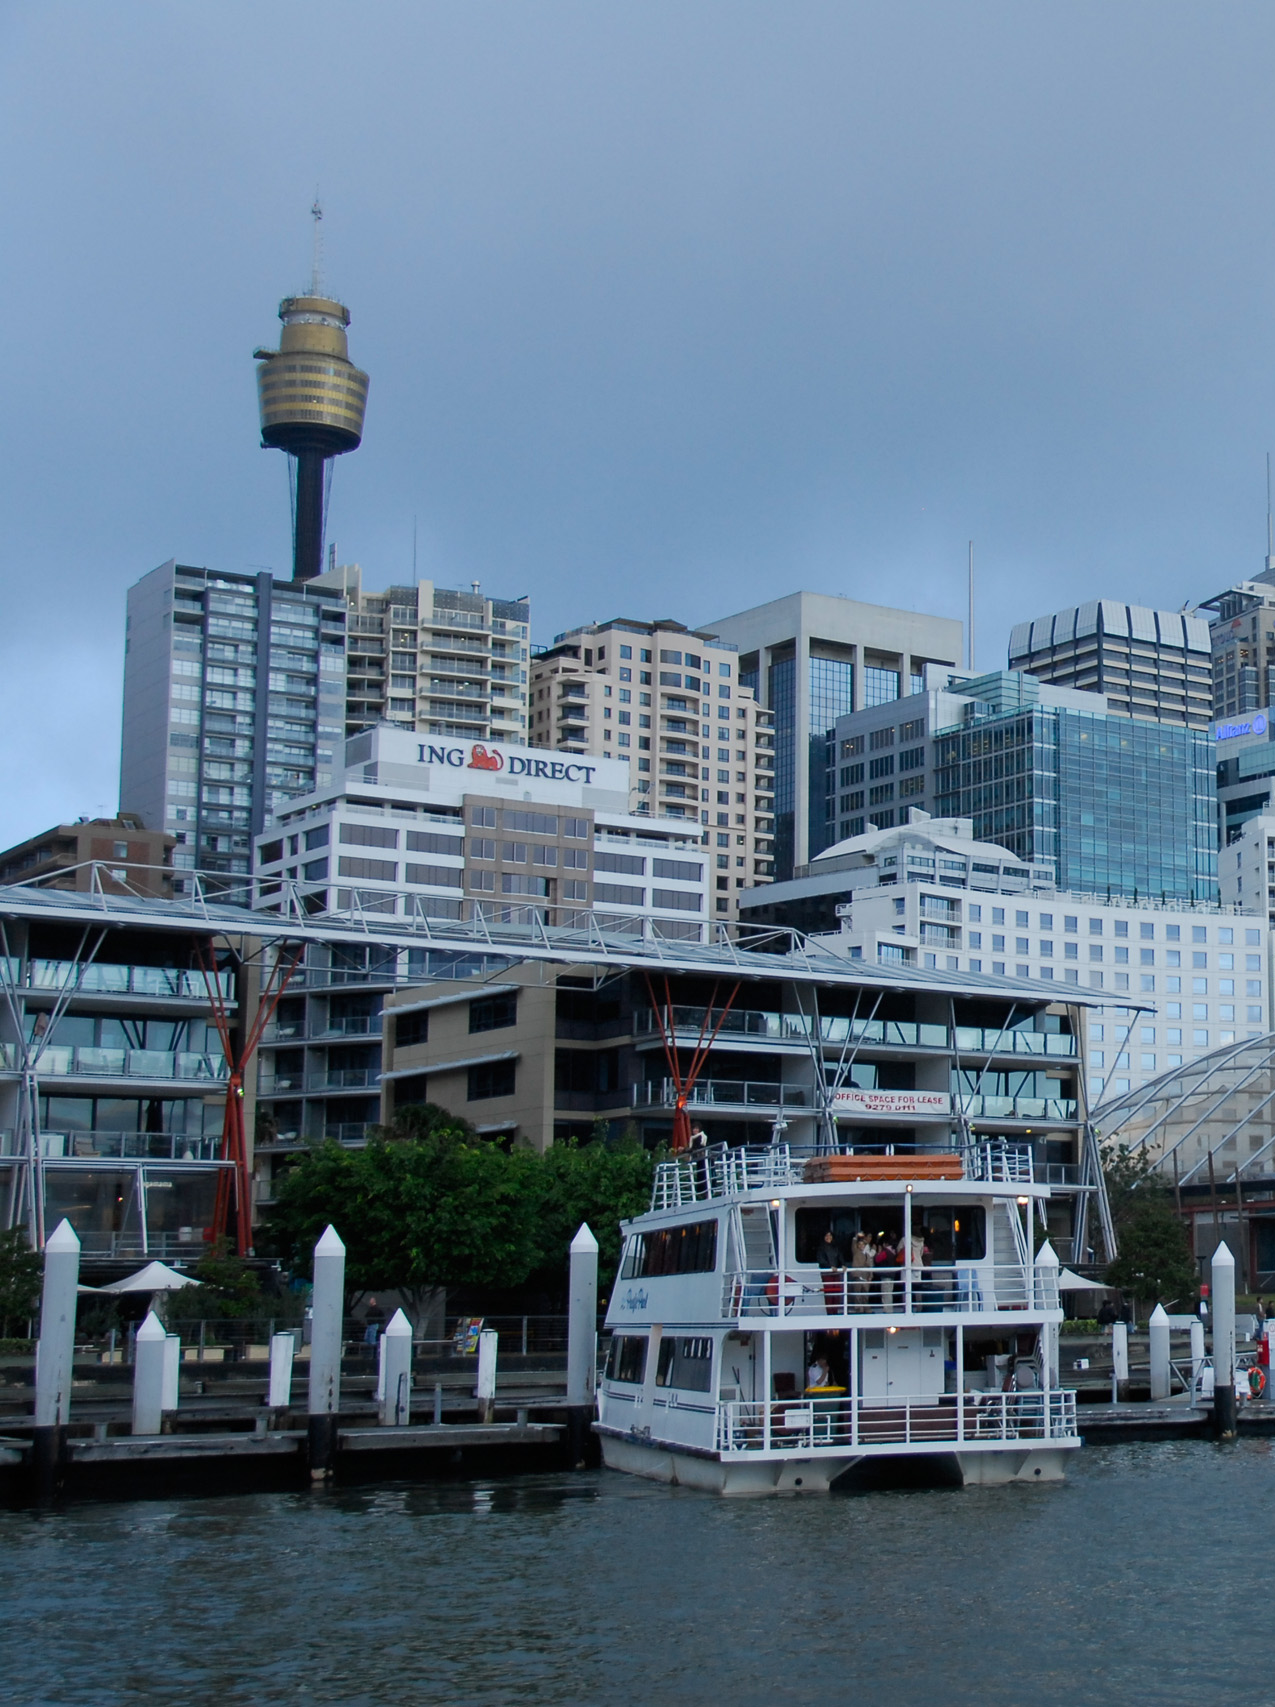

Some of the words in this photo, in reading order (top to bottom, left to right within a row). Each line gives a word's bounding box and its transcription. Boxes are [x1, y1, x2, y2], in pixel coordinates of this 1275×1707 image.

[1215, 722, 1251, 741] Allianz
[417, 743, 465, 768] ING
[508, 756, 596, 784] DIRECT
[835, 1093, 866, 1102] OFFICE
[868, 1095, 896, 1104] SPACE
